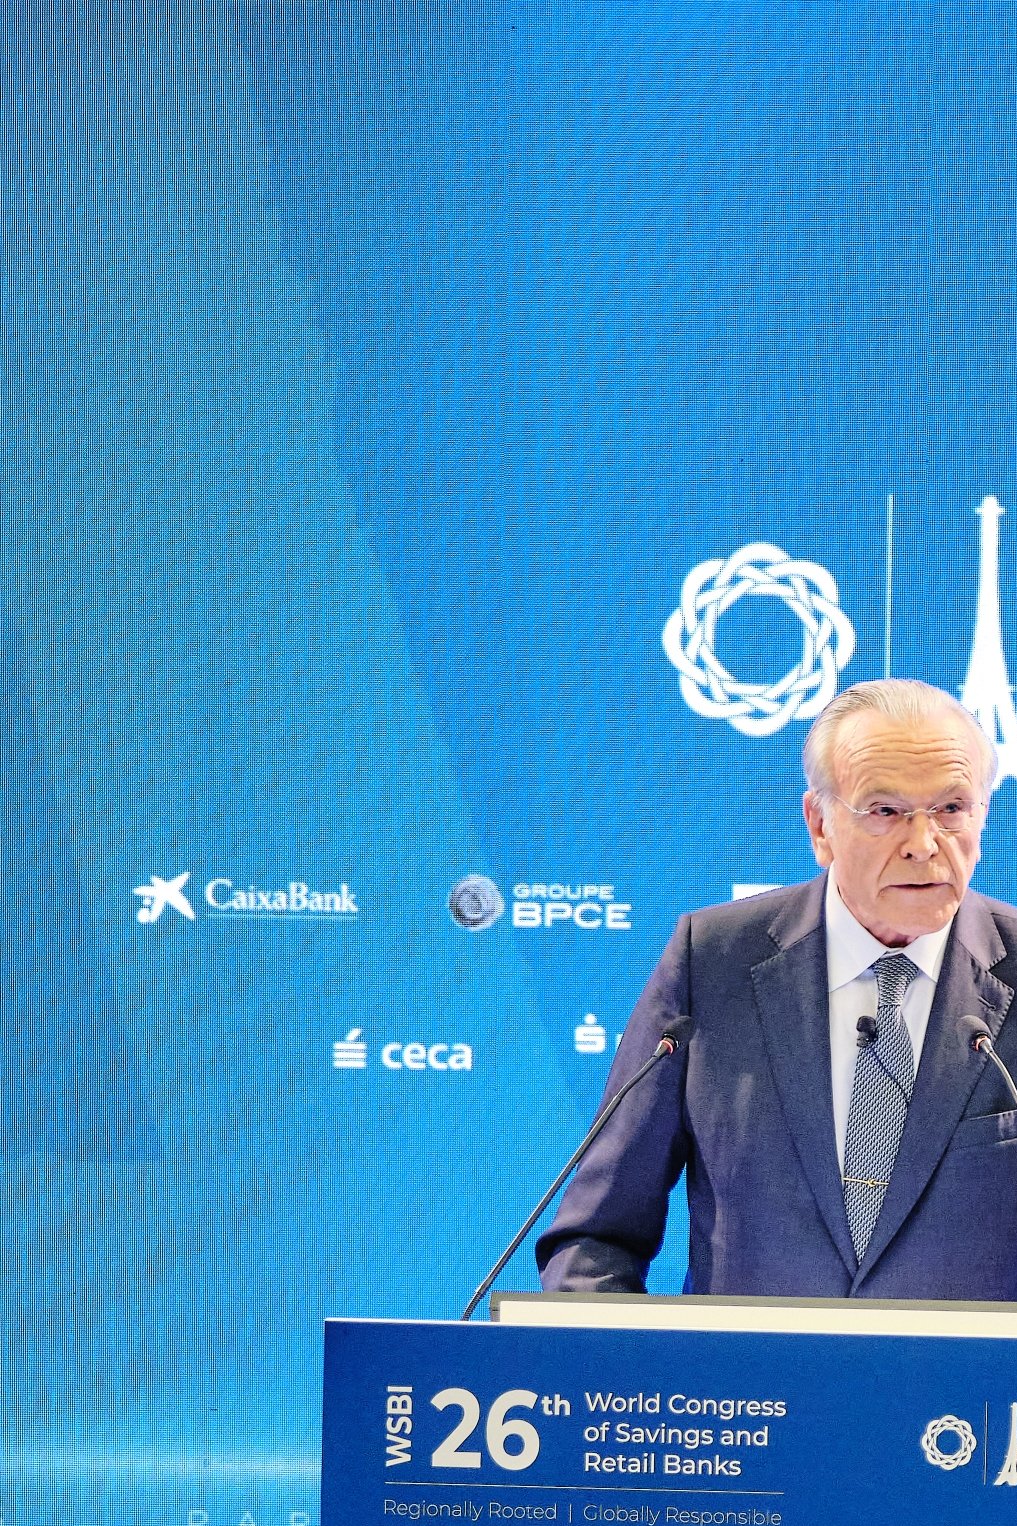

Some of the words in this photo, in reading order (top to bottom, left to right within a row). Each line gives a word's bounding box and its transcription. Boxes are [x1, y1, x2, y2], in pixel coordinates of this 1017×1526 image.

[206, 878, 358, 914] CaixaBank
[513, 883, 614, 901] GROUPE
[512, 904, 632, 929] BPCE
[381, 1040, 472, 1071] ceca
[585, 1393, 660, 1414] World
[668, 1394, 787, 1420] Congress
[385, 1386, 413, 1467] WSBI
[584, 1421, 610, 1443] of
[616, 1424, 713, 1448] Savings
[721, 1426, 768, 1446] and
[584, 1452, 655, 1474] Retail
[664, 1454, 741, 1476] Banks
[384, 1500, 483, 1520] Regionally
[489, 1502, 557, 1520] Rooted
[584, 1504, 659, 1526] Globally
